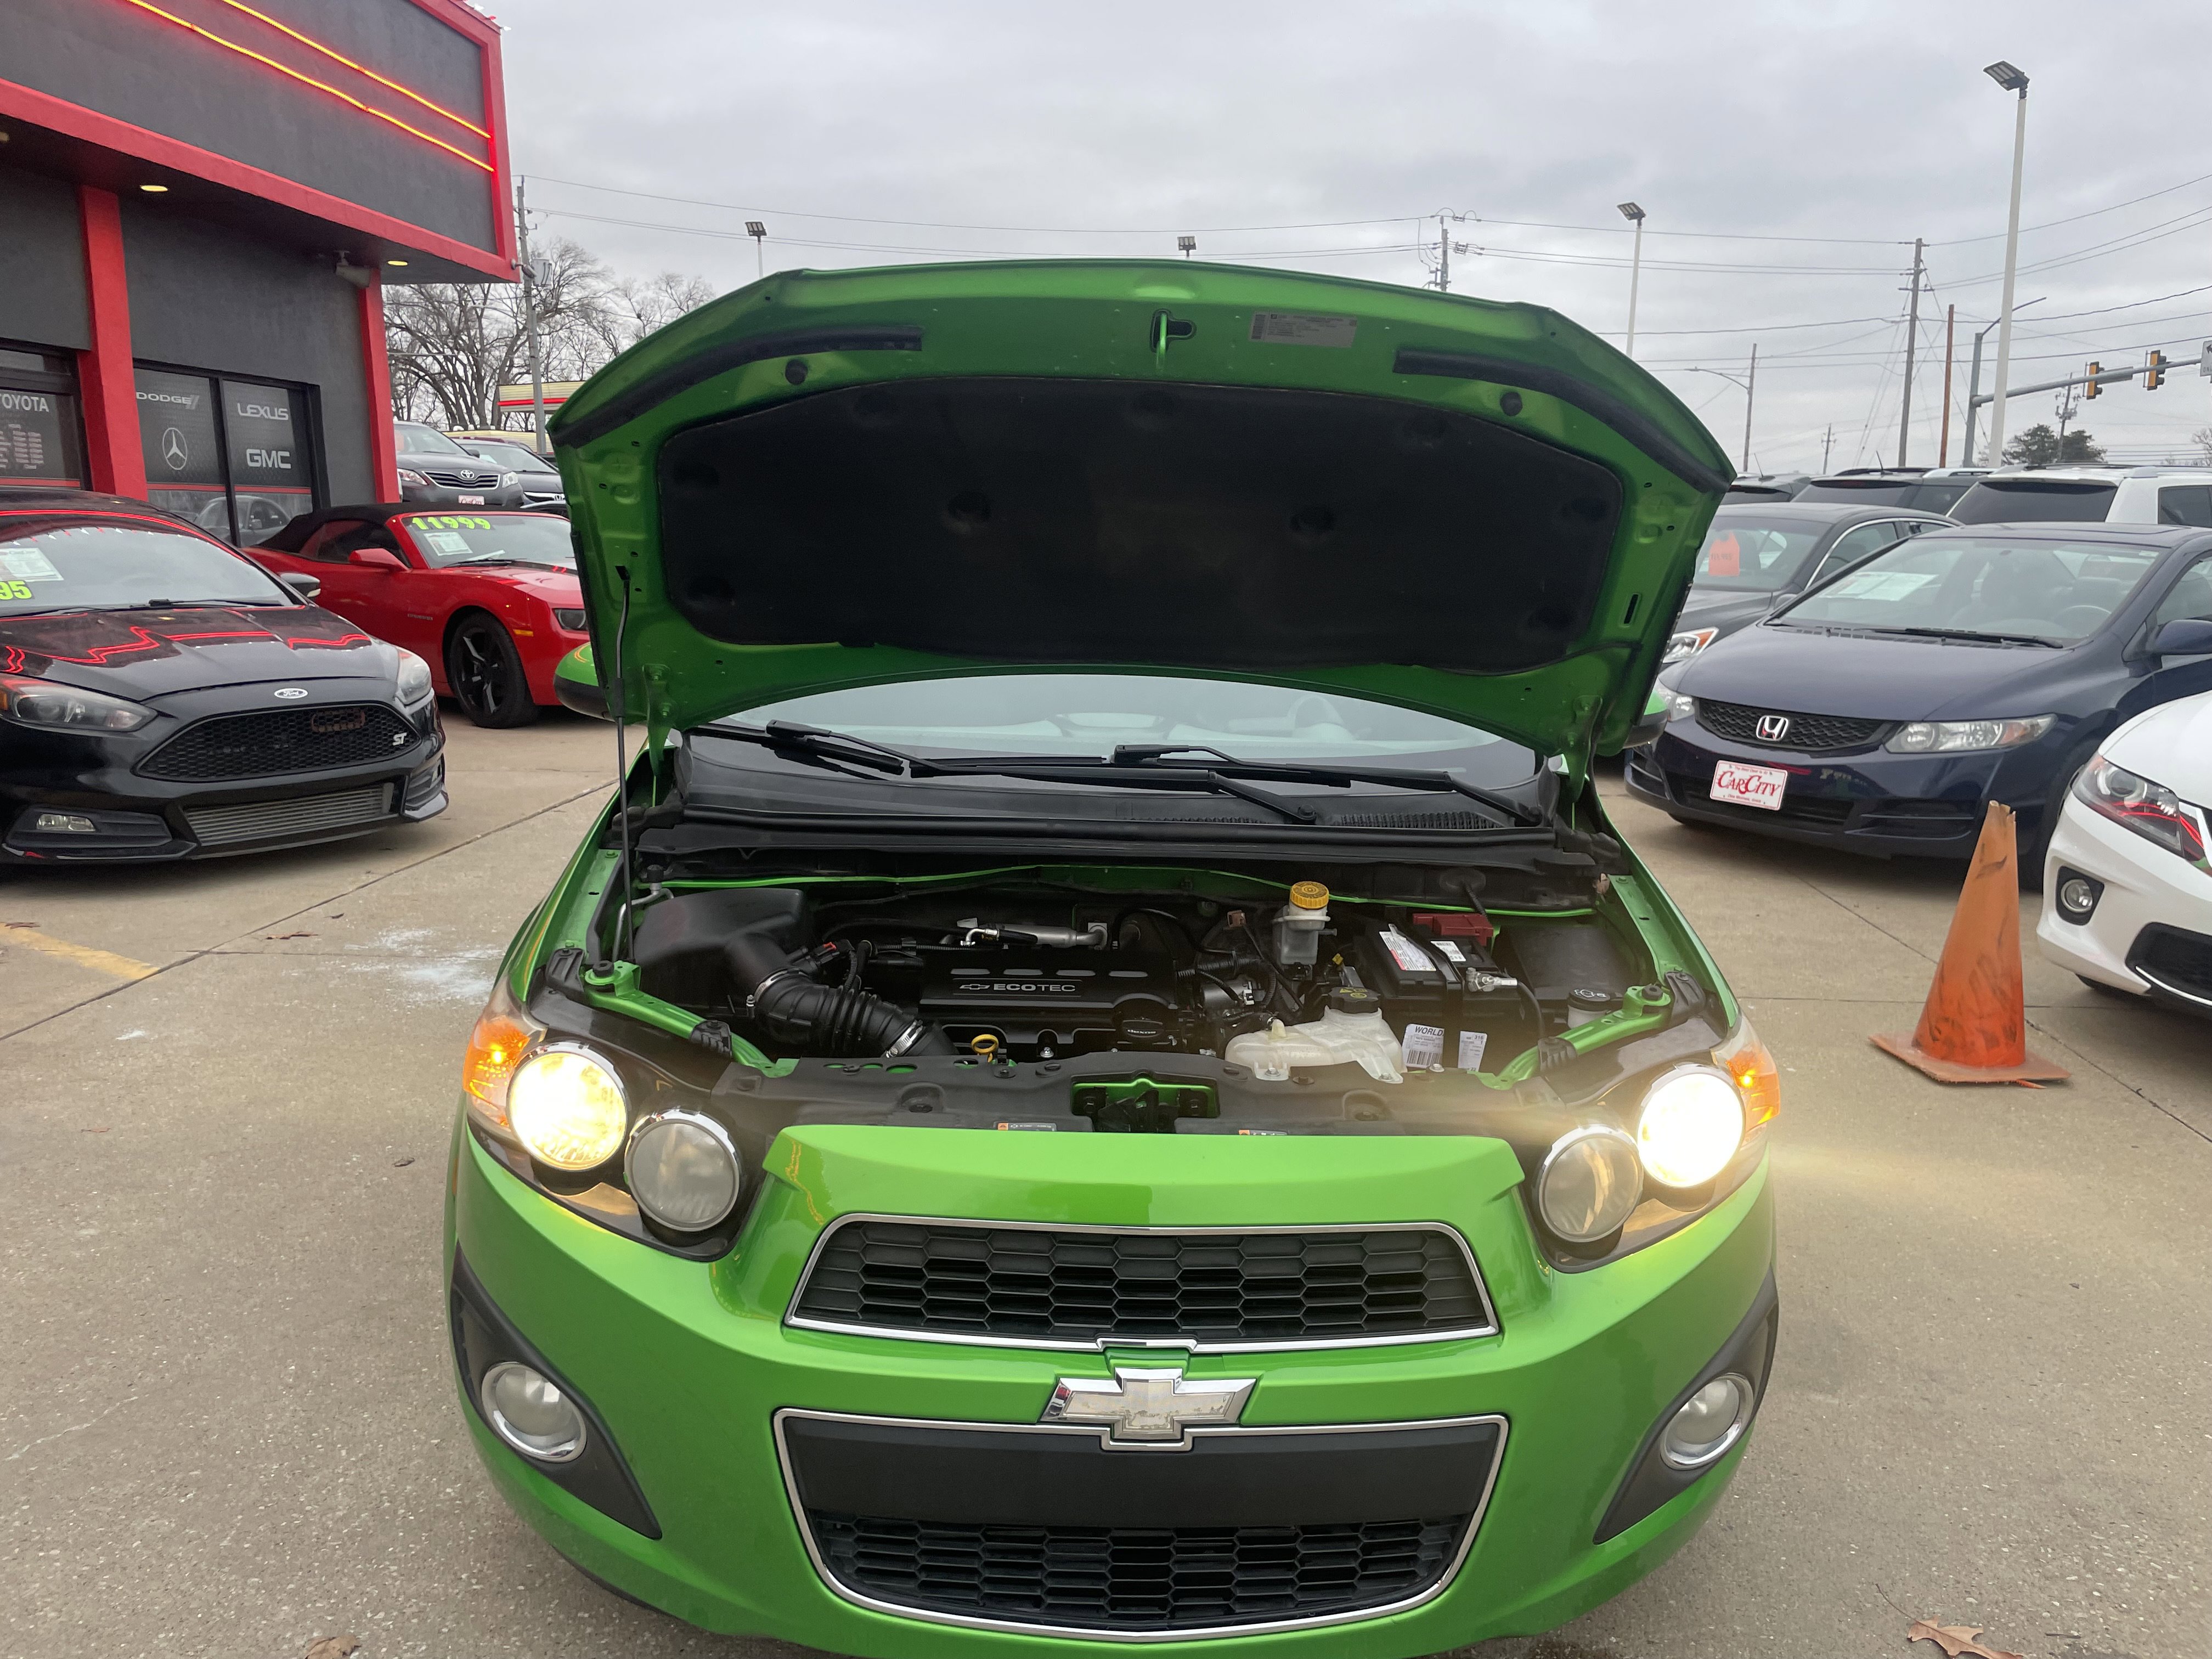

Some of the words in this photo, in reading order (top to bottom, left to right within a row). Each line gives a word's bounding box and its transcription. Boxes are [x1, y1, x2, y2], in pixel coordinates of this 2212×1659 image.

[0, 393, 49, 412] OYOTA
[136, 392, 192, 404] DODGE
[237, 403, 289, 420] LEXUS
[246, 449, 291, 469] GMC
[412, 516, 491, 530] 11999
[392, 732, 407, 746] ST
[994, 984, 1076, 992] ECOTEC
[1415, 1025, 1444, 1036] WORLD
